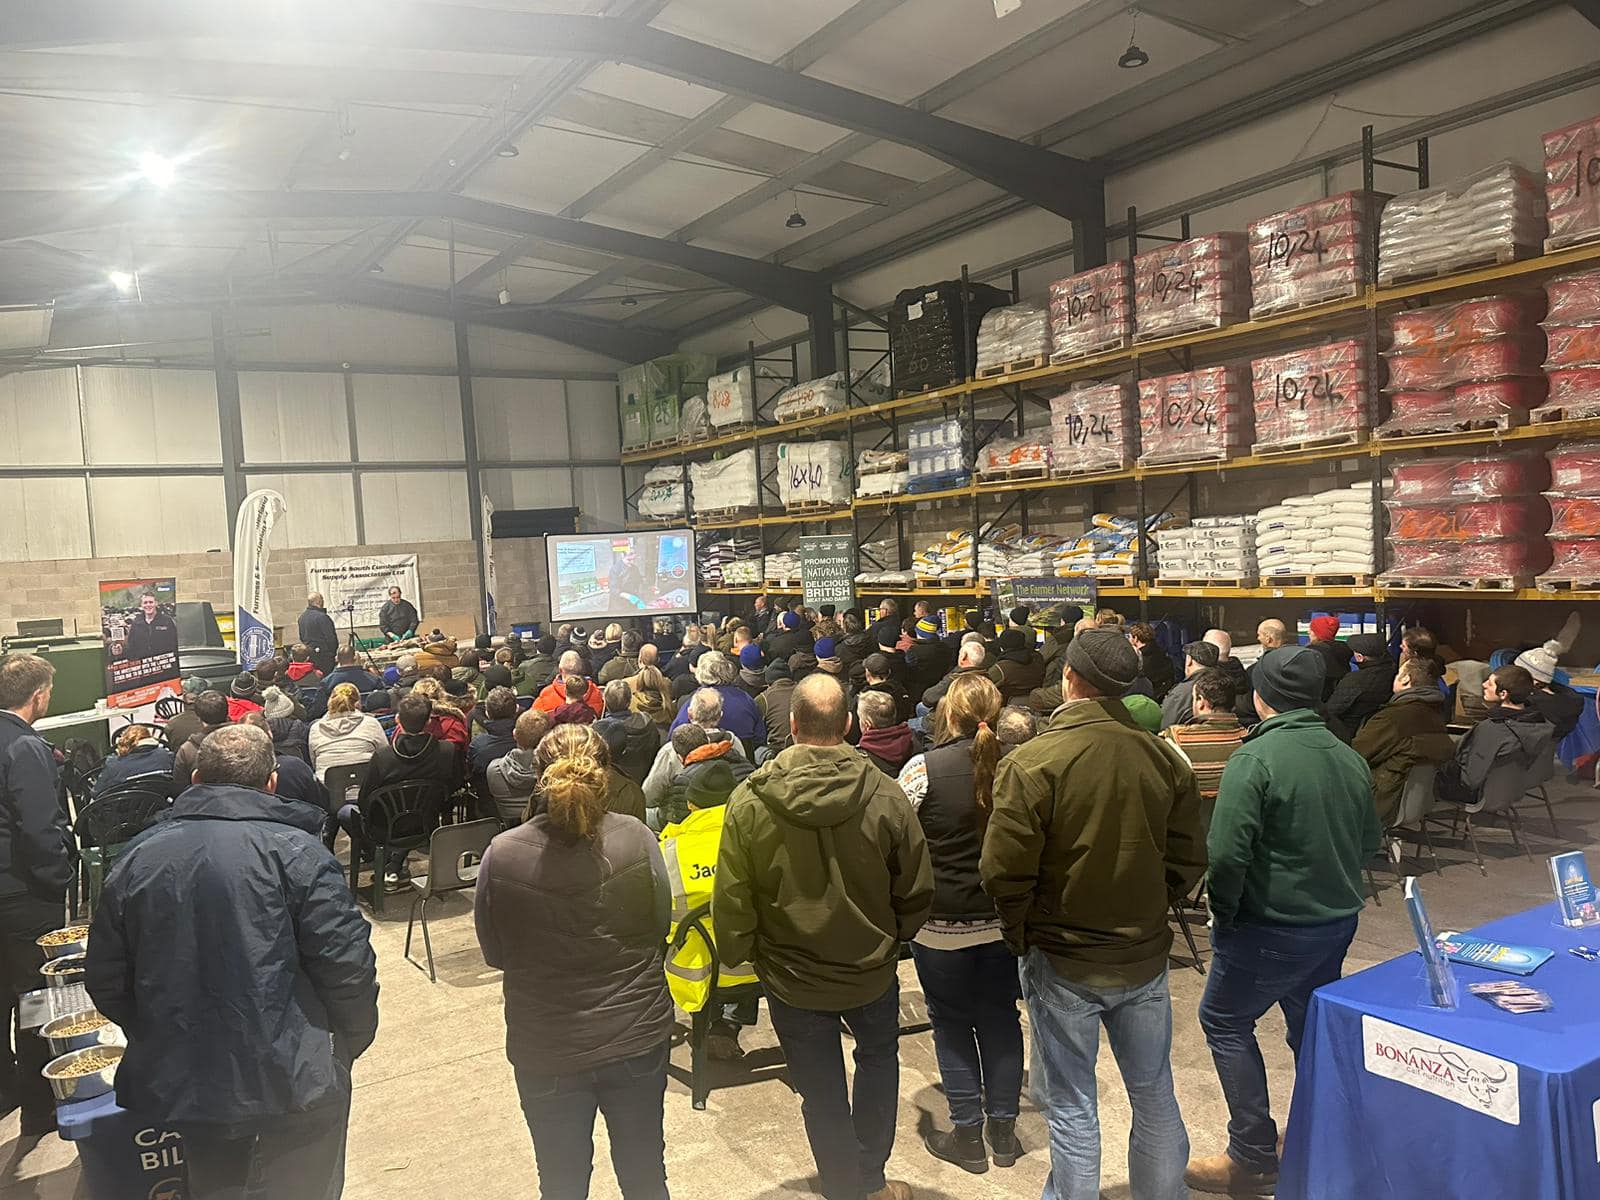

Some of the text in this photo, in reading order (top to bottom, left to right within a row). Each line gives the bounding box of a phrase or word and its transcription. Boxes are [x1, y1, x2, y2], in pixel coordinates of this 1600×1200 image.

[804, 557, 849, 566] PROMOTING
[805, 580, 850, 588] DELICIOUS
[1015, 584, 1089, 595] The Farmer Network
[806, 587, 850, 598] BRITISH
[1375, 1042, 1455, 1082] BONANZA
